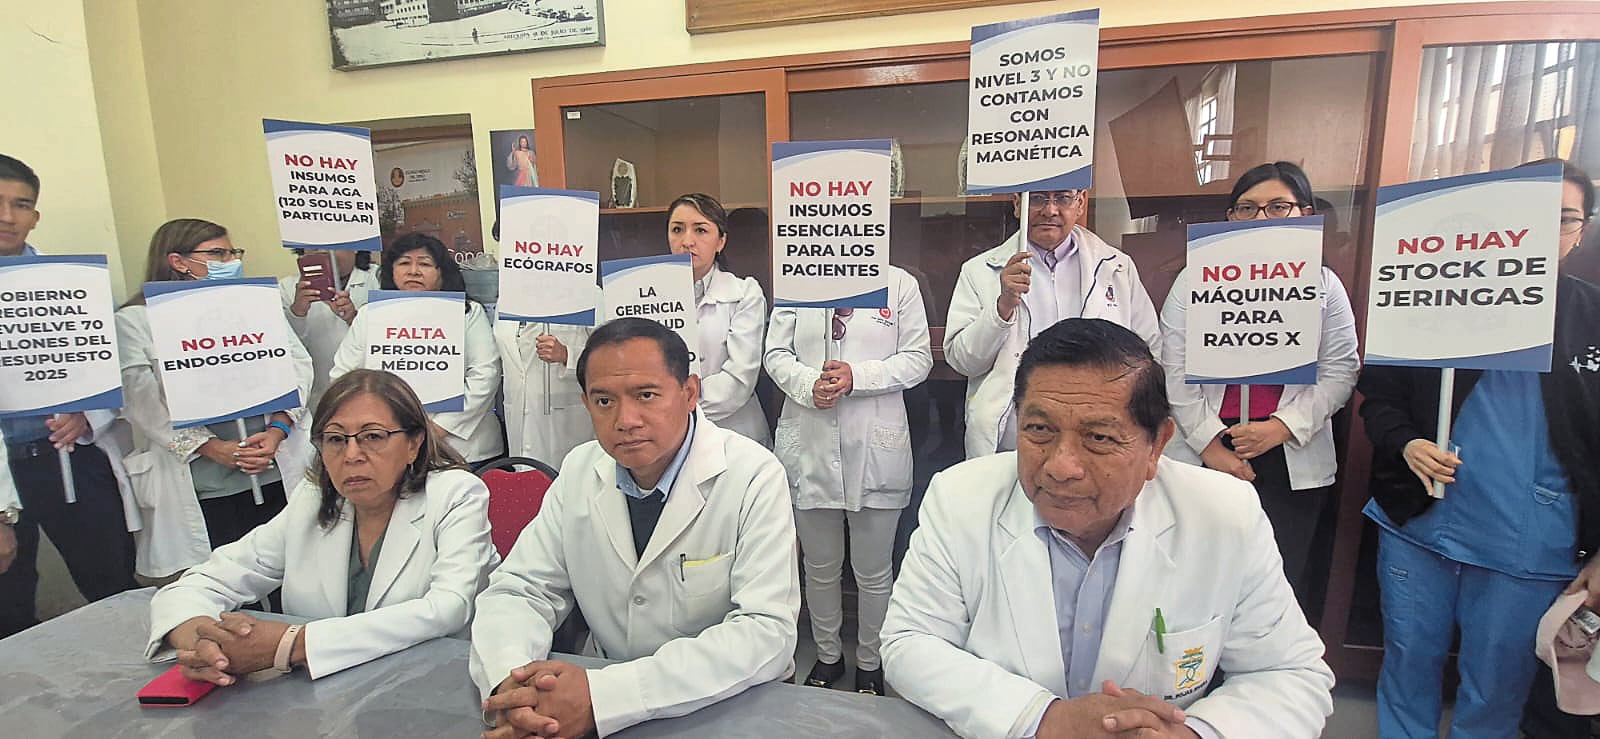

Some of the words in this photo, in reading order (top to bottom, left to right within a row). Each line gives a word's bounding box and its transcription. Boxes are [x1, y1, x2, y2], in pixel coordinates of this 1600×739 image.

[1000, 47, 1066, 66] SOMOS
[975, 72, 1026, 88] NIVEL
[1030, 70, 1040, 82] 3
[1046, 68, 1057, 80] Y
[1063, 64, 1091, 78] NO
[980, 85, 1083, 107] CONTAMOS
[1010, 108, 1049, 123] CON
[972, 125, 1089, 145] RESONANCIA
[285, 154, 313, 167] NO
[320, 156, 358, 170] HAY
[976, 145, 1082, 164] MAGNÉTICA
[291, 171, 356, 184] INSUMOS
[289, 184, 328, 195] PARA
[332, 187, 362, 197] AGA
[790, 182, 821, 196] NO
[828, 181, 872, 196] HAY
[279, 197, 305, 208] (120
[309, 199, 352, 209] SOLES
[356, 202, 374, 211] EN
[790, 203, 872, 217] INSUMOS
[283, 211, 373, 225] PARTICULAR)
[777, 224, 885, 237] ESENCIALES
[515, 241, 541, 254] NO
[548, 243, 583, 257] HAY
[1398, 236, 1444, 255] NO
[1456, 229, 1529, 251] HAY
[787, 244, 835, 256] PARA
[841, 244, 875, 257] LOS
[504, 255, 593, 273] ECÓGRAFOS
[782, 264, 879, 277] PACIENTES
[1378, 260, 1486, 281] STOCK
[1496, 257, 1547, 278] DE
[1203, 265, 1241, 282] NO
[1250, 262, 1306, 280] HAY
[0, 289, 87, 302] OBIERNO
[639, 286, 656, 298] LA
[1192, 285, 1316, 305] MÁQUINAS
[1376, 287, 1544, 308] JERINGAS
[0, 305, 88, 318] EGIONAL
[616, 301, 684, 318] GERENCIA
[1221, 308, 1284, 325] PARA
[0, 321, 77, 334] VUELVE
[81, 320, 103, 330] 70
[386, 328, 446, 339] FALTA
[0, 337, 69, 350] LLONES
[75, 335, 111, 346] DEL
[182, 337, 215, 352] NO
[222, 333, 264, 347] HAY
[1204, 331, 1279, 348] RAYOS
[1285, 332, 1301, 347] X
[371, 344, 461, 355] PERSONAL
[0, 350, 112, 367] ESUPUESTO
[164, 347, 286, 371] ENDOSCOPIO
[381, 358, 448, 372] MÉDICO
[24, 369, 68, 381] 2025
